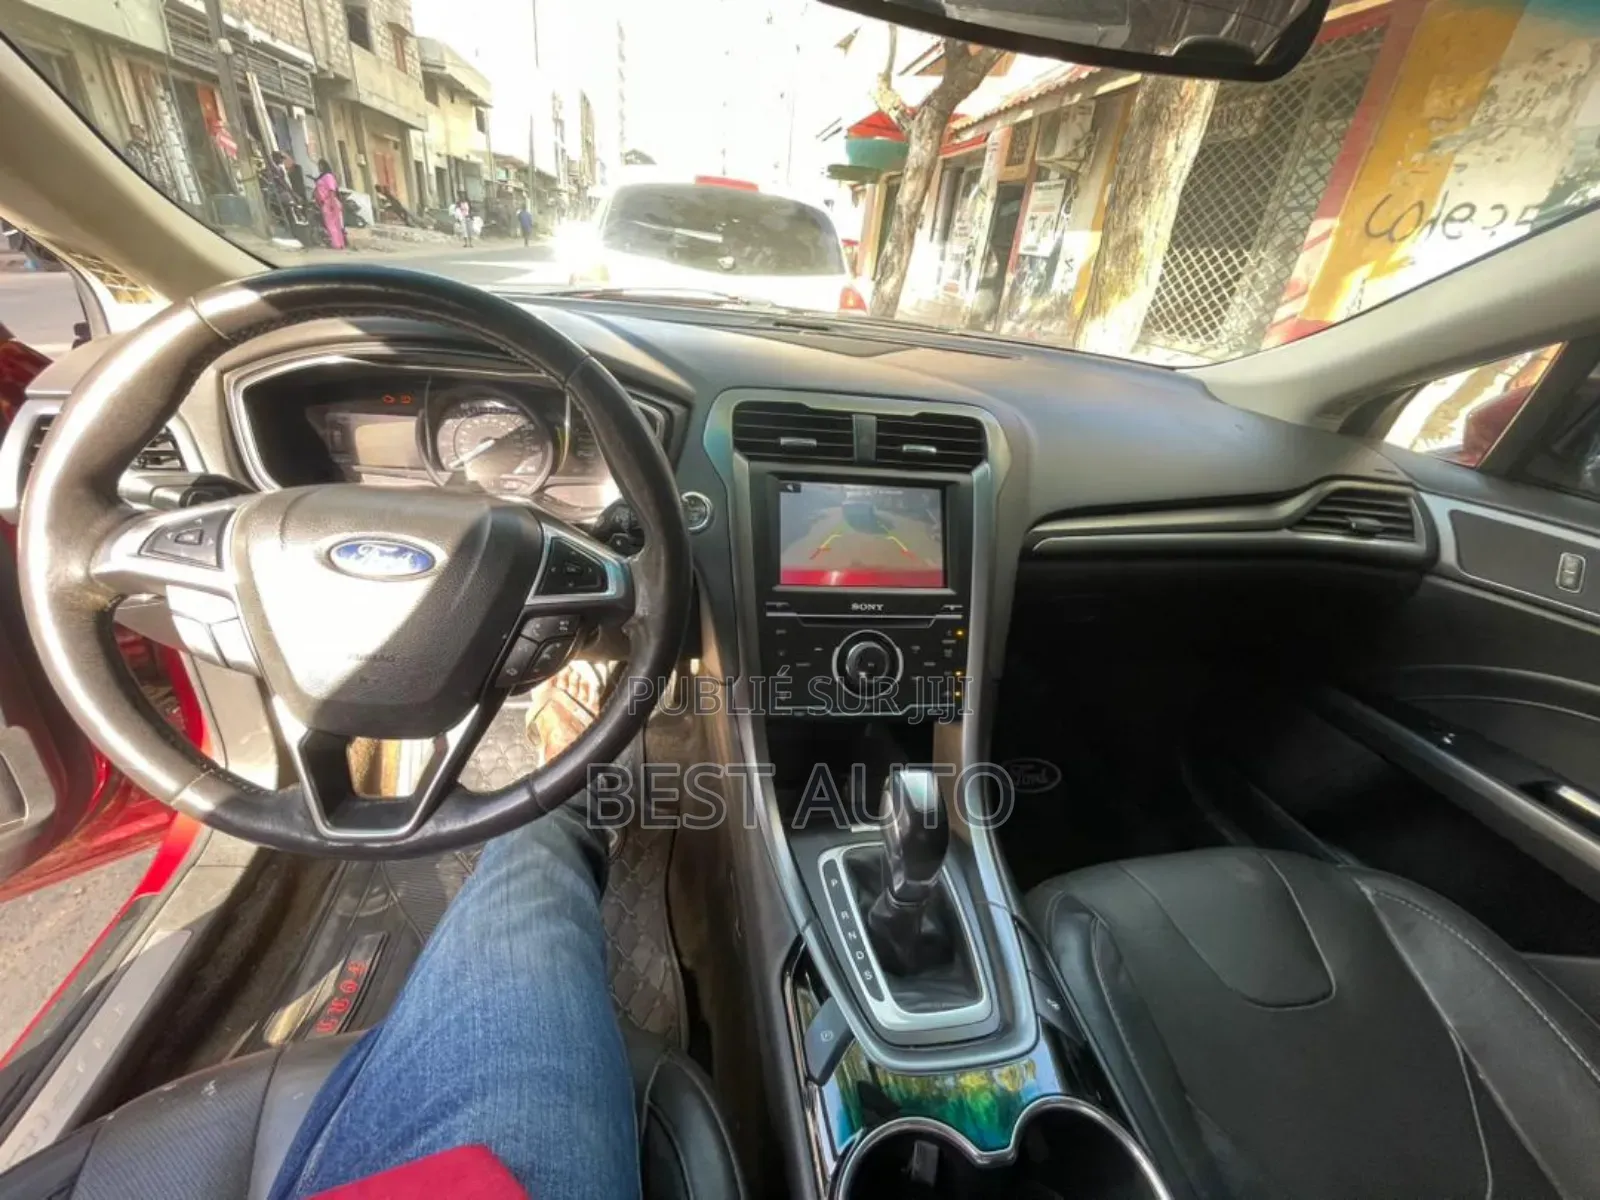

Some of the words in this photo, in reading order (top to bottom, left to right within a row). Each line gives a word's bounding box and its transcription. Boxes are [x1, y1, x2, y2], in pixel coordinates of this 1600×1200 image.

[851, 602, 884, 611] SONY
[841, 910, 850, 919] R
[848, 931, 857, 940] N
[856, 951, 865, 959] D
[864, 971, 873, 980] S
